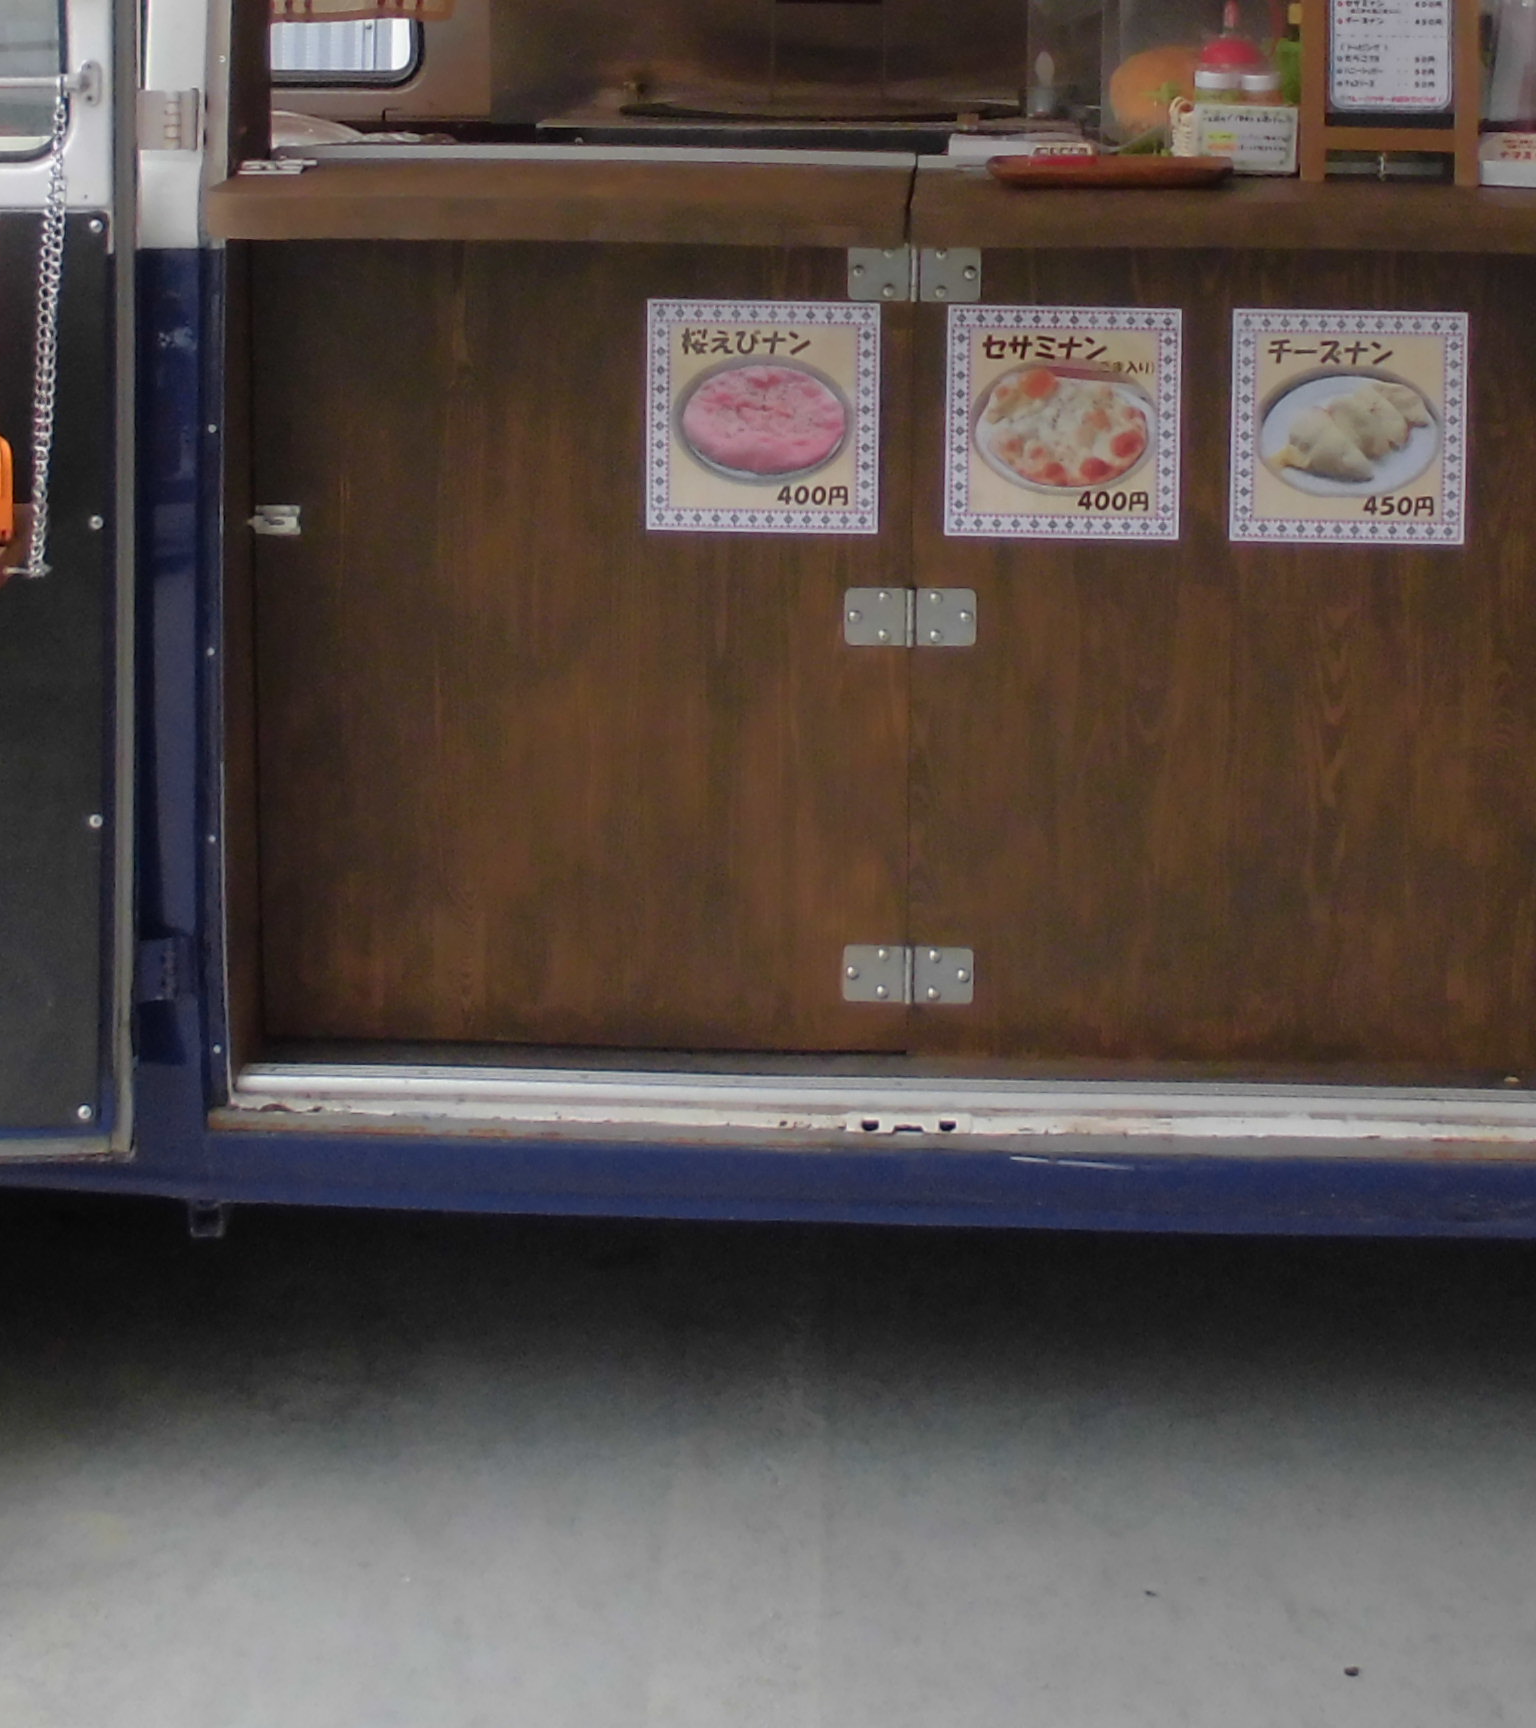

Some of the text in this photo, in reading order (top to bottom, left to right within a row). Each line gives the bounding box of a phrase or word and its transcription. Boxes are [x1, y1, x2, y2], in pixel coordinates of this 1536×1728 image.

[681, 327, 811, 355] 桜えびナン
[982, 335, 1107, 360] セサミナン
[1267, 338, 1393, 364] チーズナン
[776, 485, 849, 506] 400円
[1077, 490, 1149, 511] 400円
[1362, 495, 1435, 517] 450円
